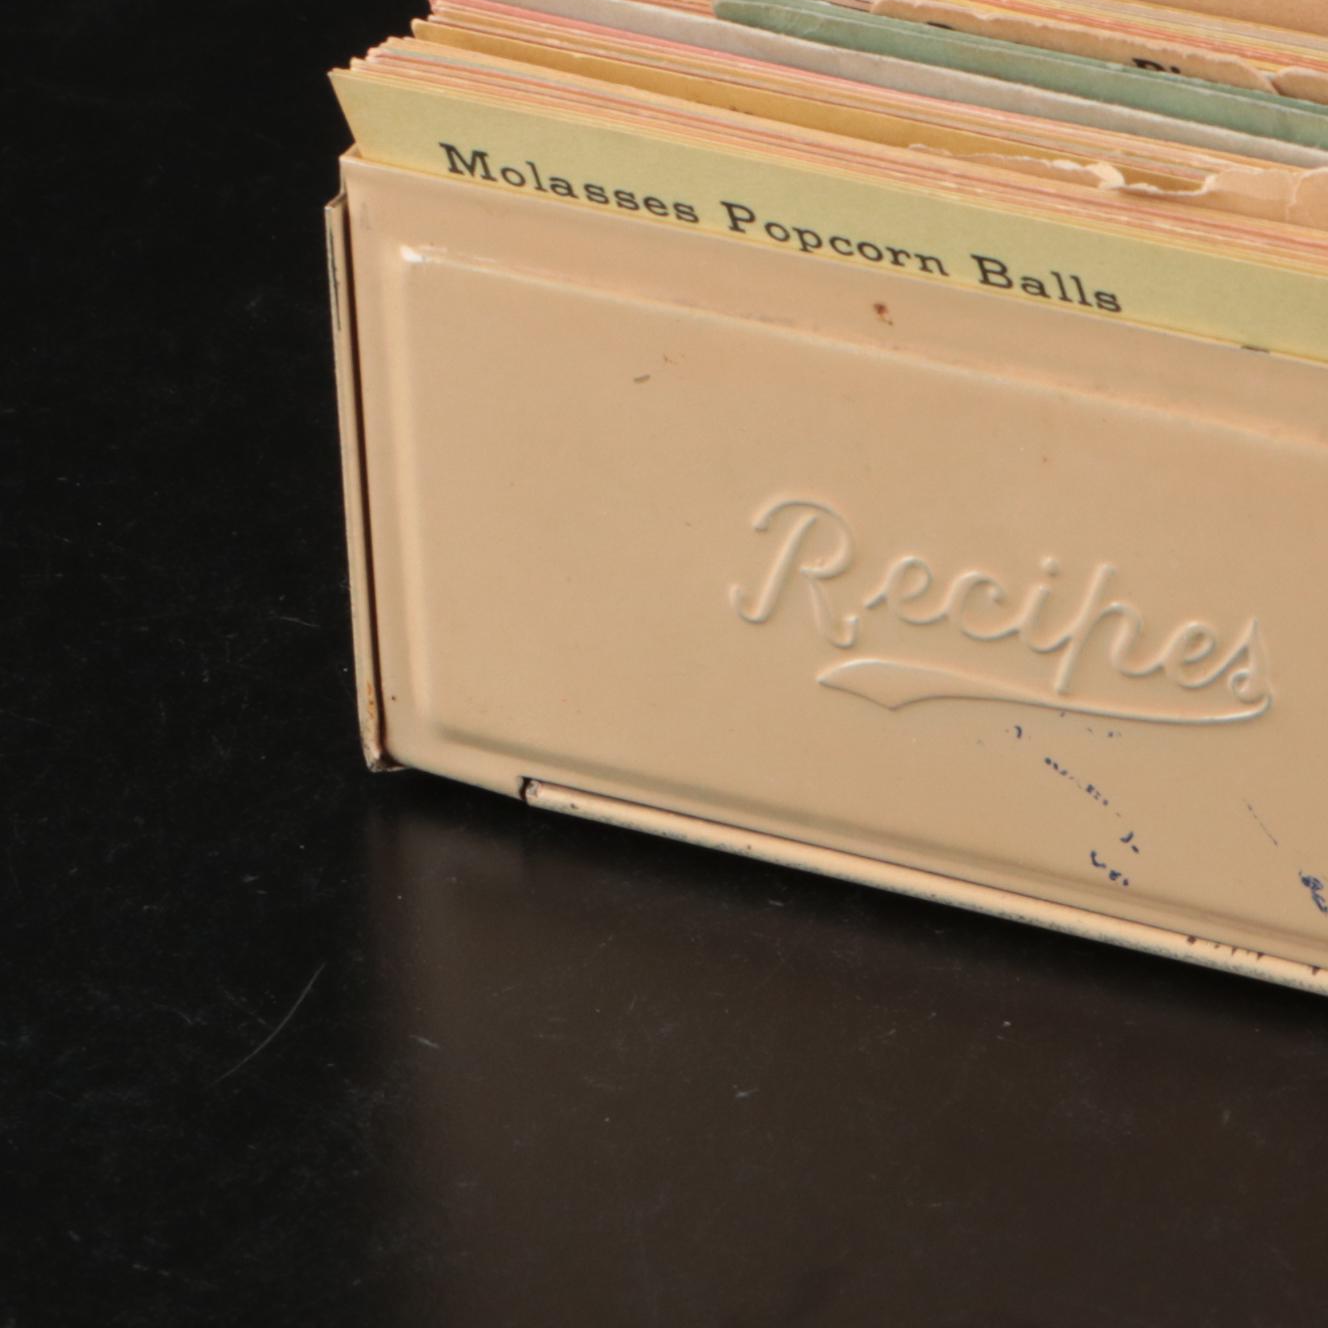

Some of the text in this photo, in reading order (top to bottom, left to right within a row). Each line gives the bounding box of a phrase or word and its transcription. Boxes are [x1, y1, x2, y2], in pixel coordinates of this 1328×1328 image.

[438, 141, 1123, 314] Molasses Popcorn Balls
[728, 498, 1276, 706] Recipes
